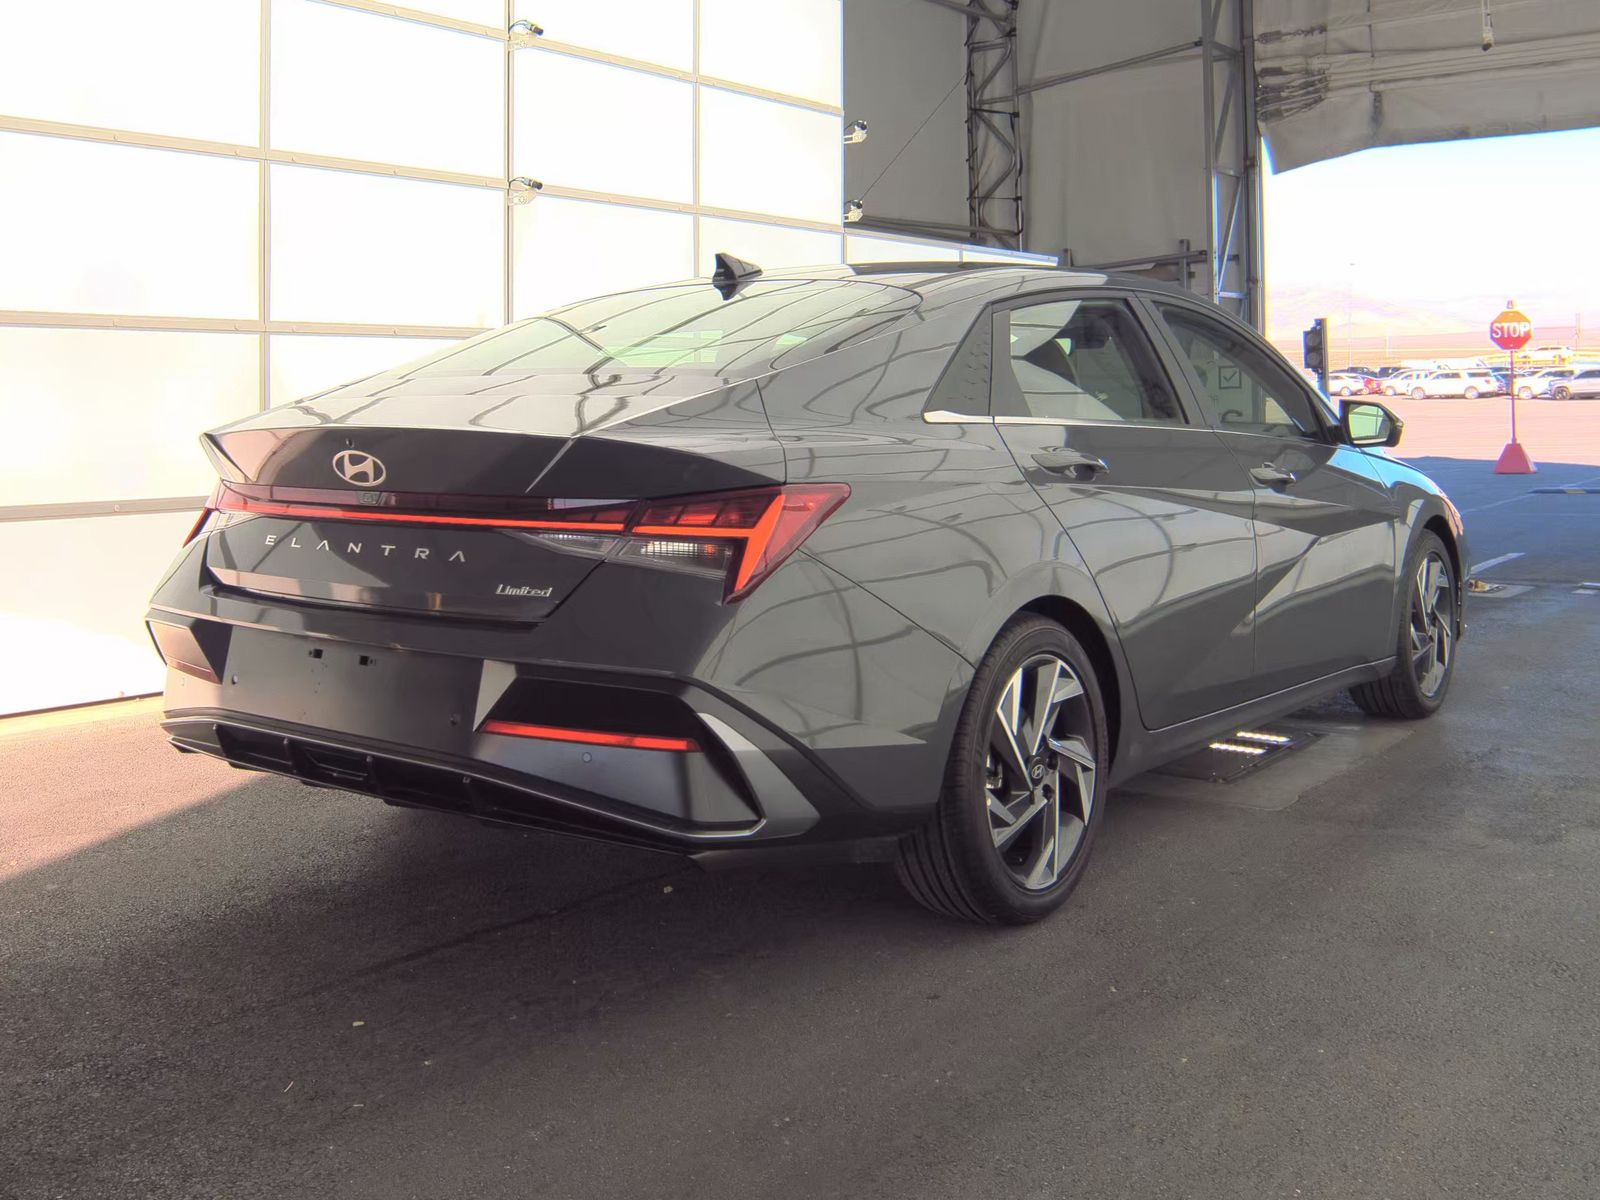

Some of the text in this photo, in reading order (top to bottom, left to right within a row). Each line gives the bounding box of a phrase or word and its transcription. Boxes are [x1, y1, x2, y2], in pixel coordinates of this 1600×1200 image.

[1492, 322, 1530, 338] STOP
[264, 535, 466, 563] ELANTRA
[496, 584, 552, 597] Limited
